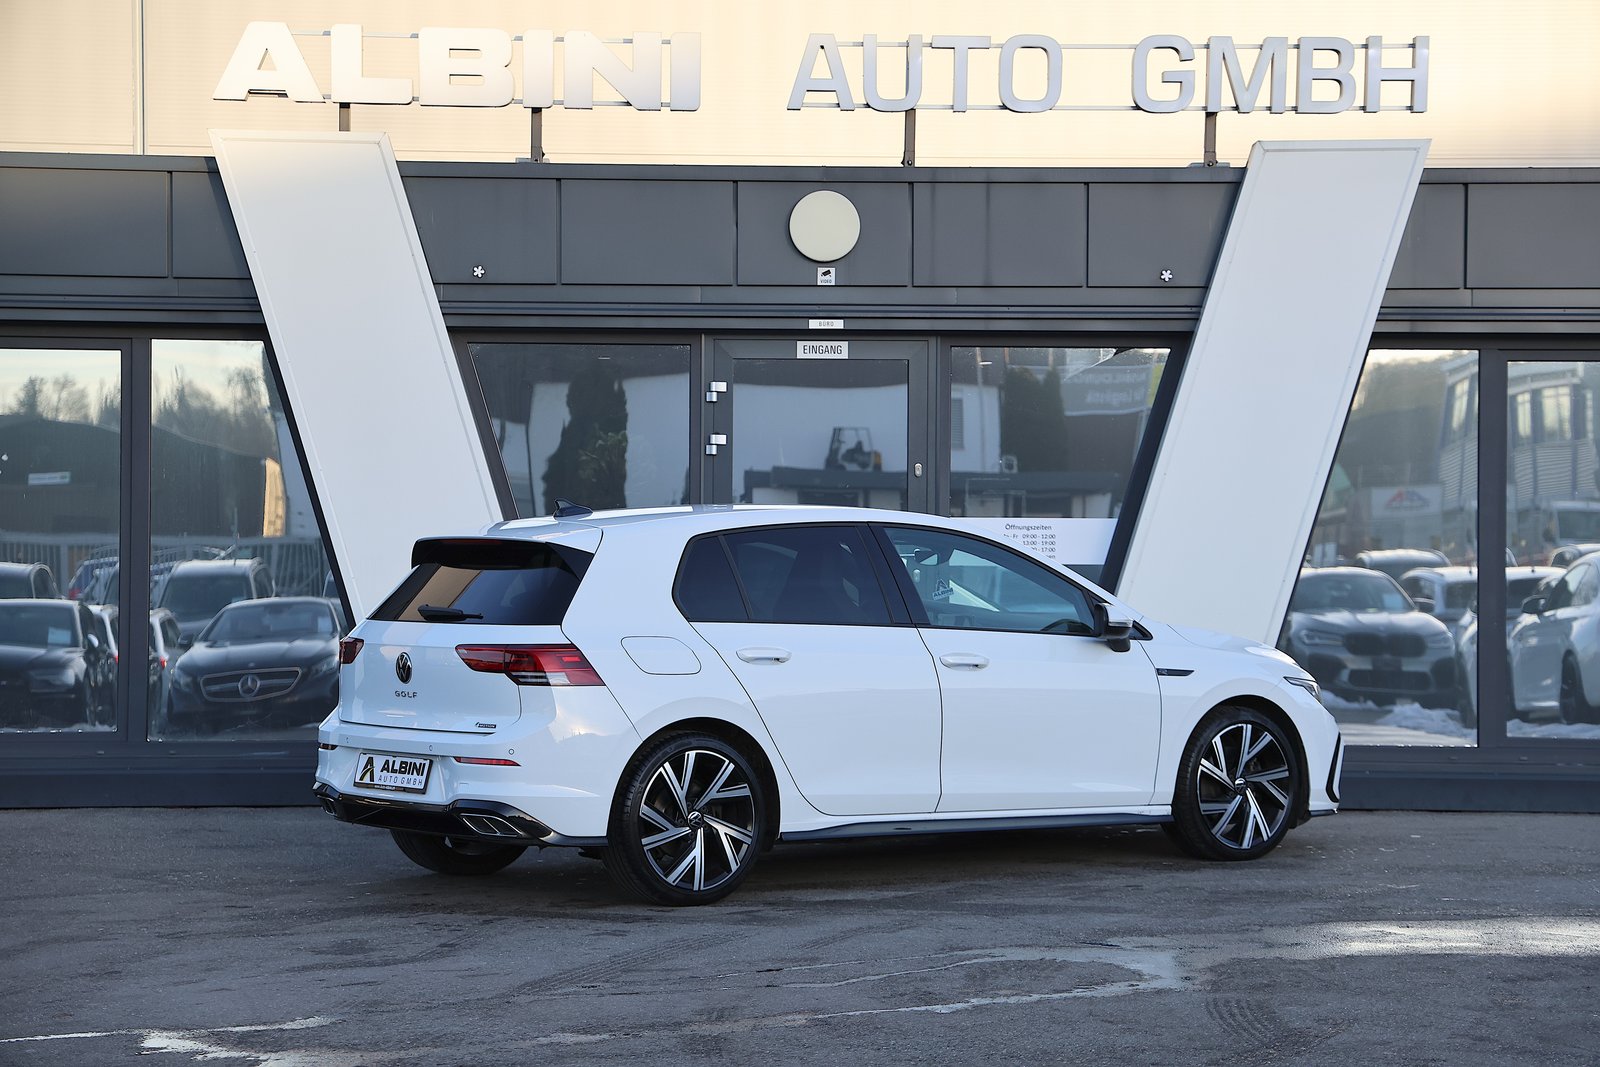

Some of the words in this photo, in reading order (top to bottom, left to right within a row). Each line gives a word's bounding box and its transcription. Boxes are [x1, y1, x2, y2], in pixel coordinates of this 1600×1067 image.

[213, 21, 702, 111] ALBINI
[787, 33, 1063, 113] AUTO
[1132, 34, 1430, 114] GMBH
[802, 344, 843, 355] EINGANG
[1004, 523, 1052, 531] Öffnungszeiten
[394, 690, 418, 699] GOLF
[380, 759, 426, 777] ALBINI
[378, 775, 398, 784] AUTO
[400, 776, 423, 787] GMBH
